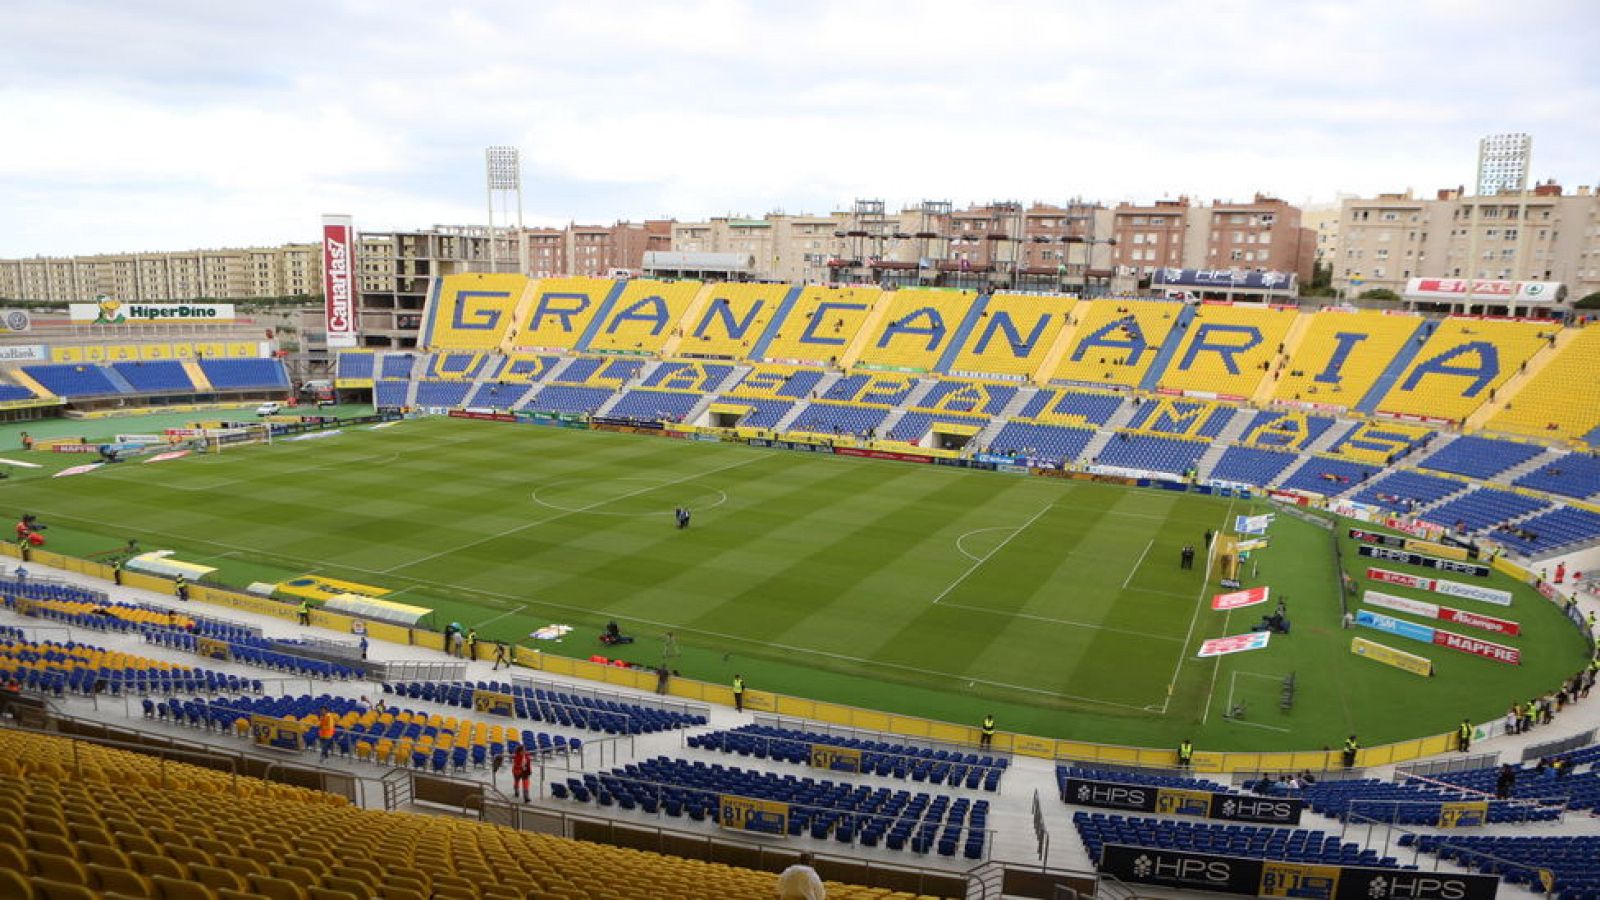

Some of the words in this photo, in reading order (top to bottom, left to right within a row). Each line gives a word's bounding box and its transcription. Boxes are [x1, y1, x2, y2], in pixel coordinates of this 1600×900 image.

[327, 237, 347, 331] Canarias7
[130, 306, 217, 320] HiperDino
[452, 290, 766, 340] GRAN
[800, 302, 1500, 398] CANARIA
[1447, 634, 1518, 662] MAPFRE
[1092, 787, 1145, 805] HPS
[1237, 800, 1292, 818] HPS
[1155, 855, 1231, 882] HPS
[1389, 876, 1467, 899] HPS
